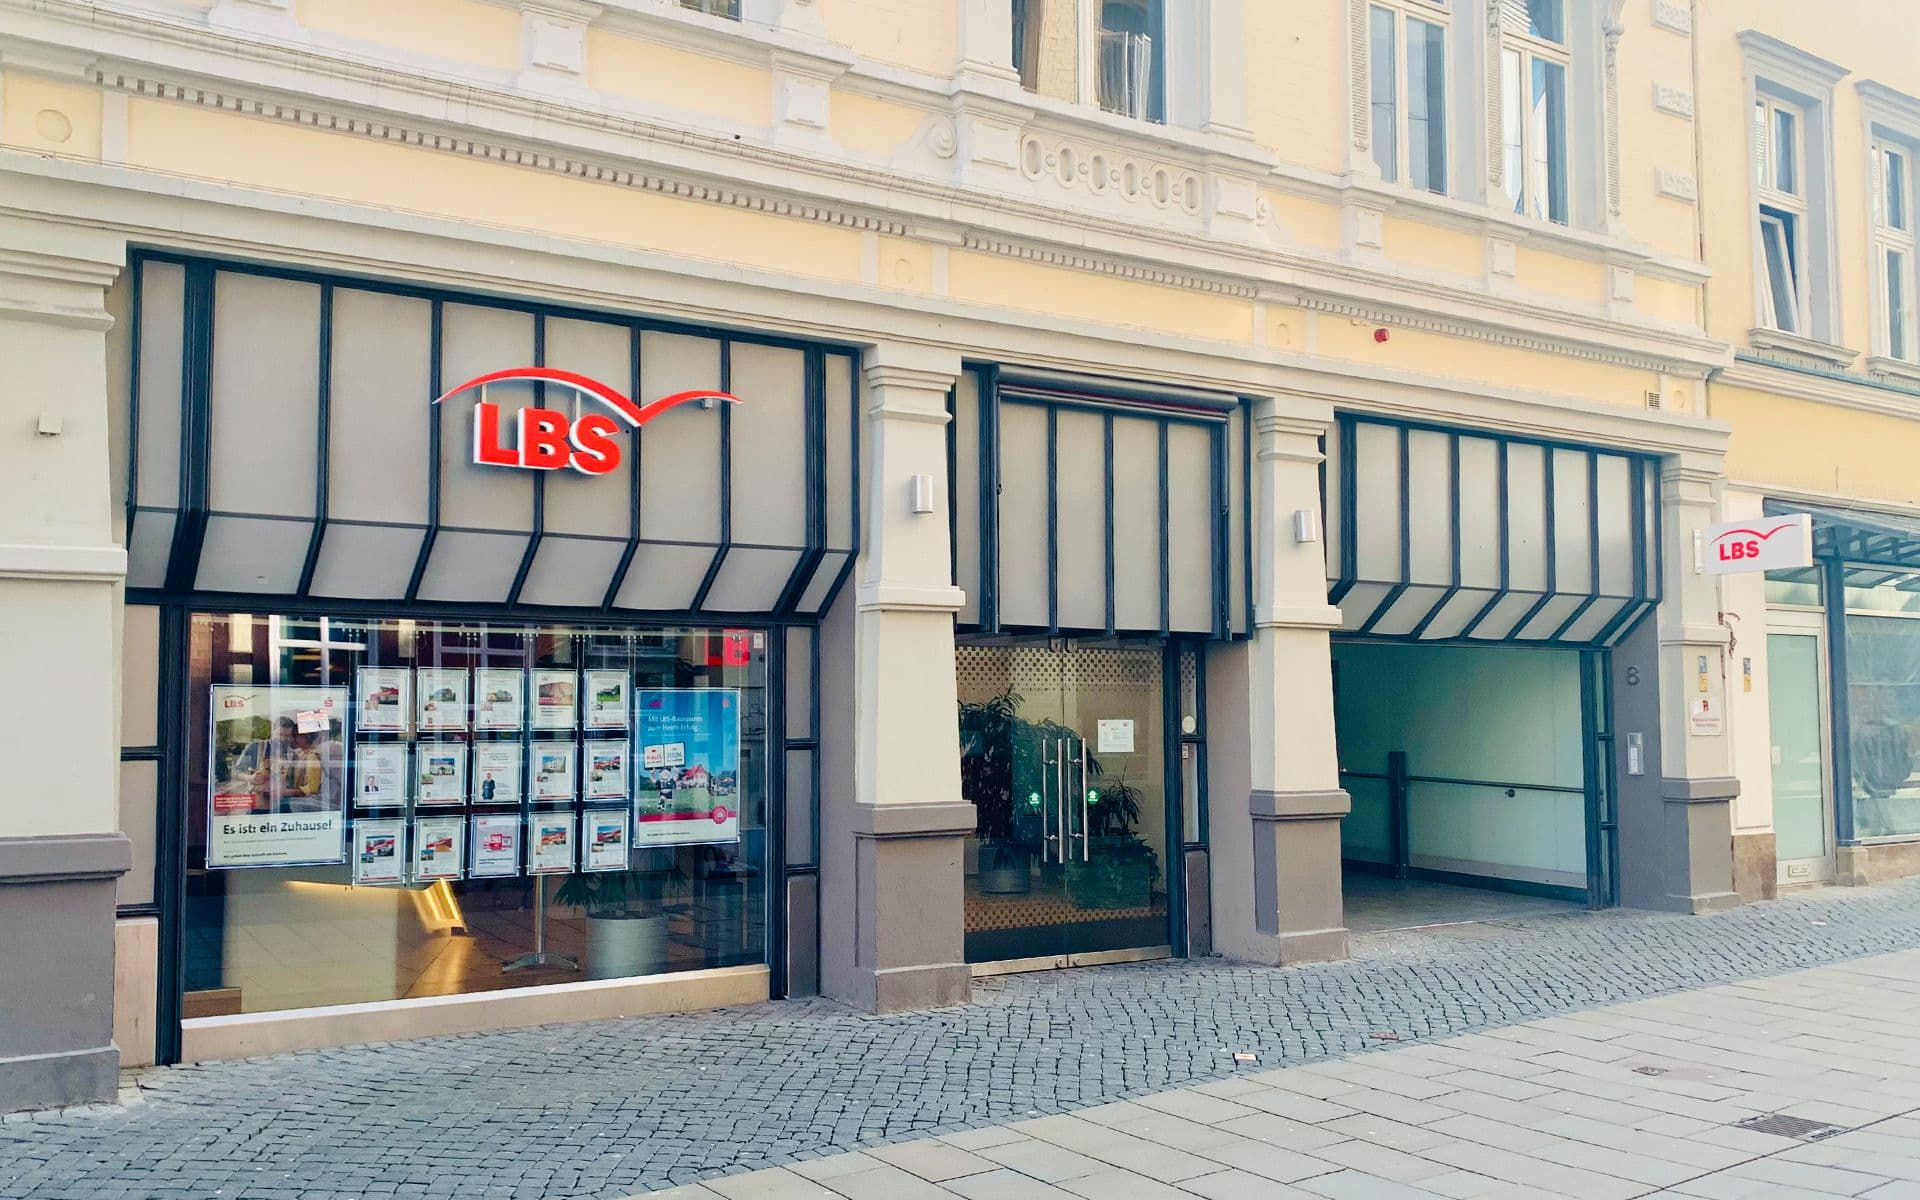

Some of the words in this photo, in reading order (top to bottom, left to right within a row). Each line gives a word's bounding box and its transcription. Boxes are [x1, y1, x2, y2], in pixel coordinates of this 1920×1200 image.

[474, 403, 621, 475] LBS
[1719, 540, 1760, 561] LBS
[224, 700, 244, 708] LBS
[223, 824, 236, 835] Es
[239, 823, 256, 834] ist:
[259, 822, 277, 833] ein
[280, 819, 332, 832] Zuhause!
